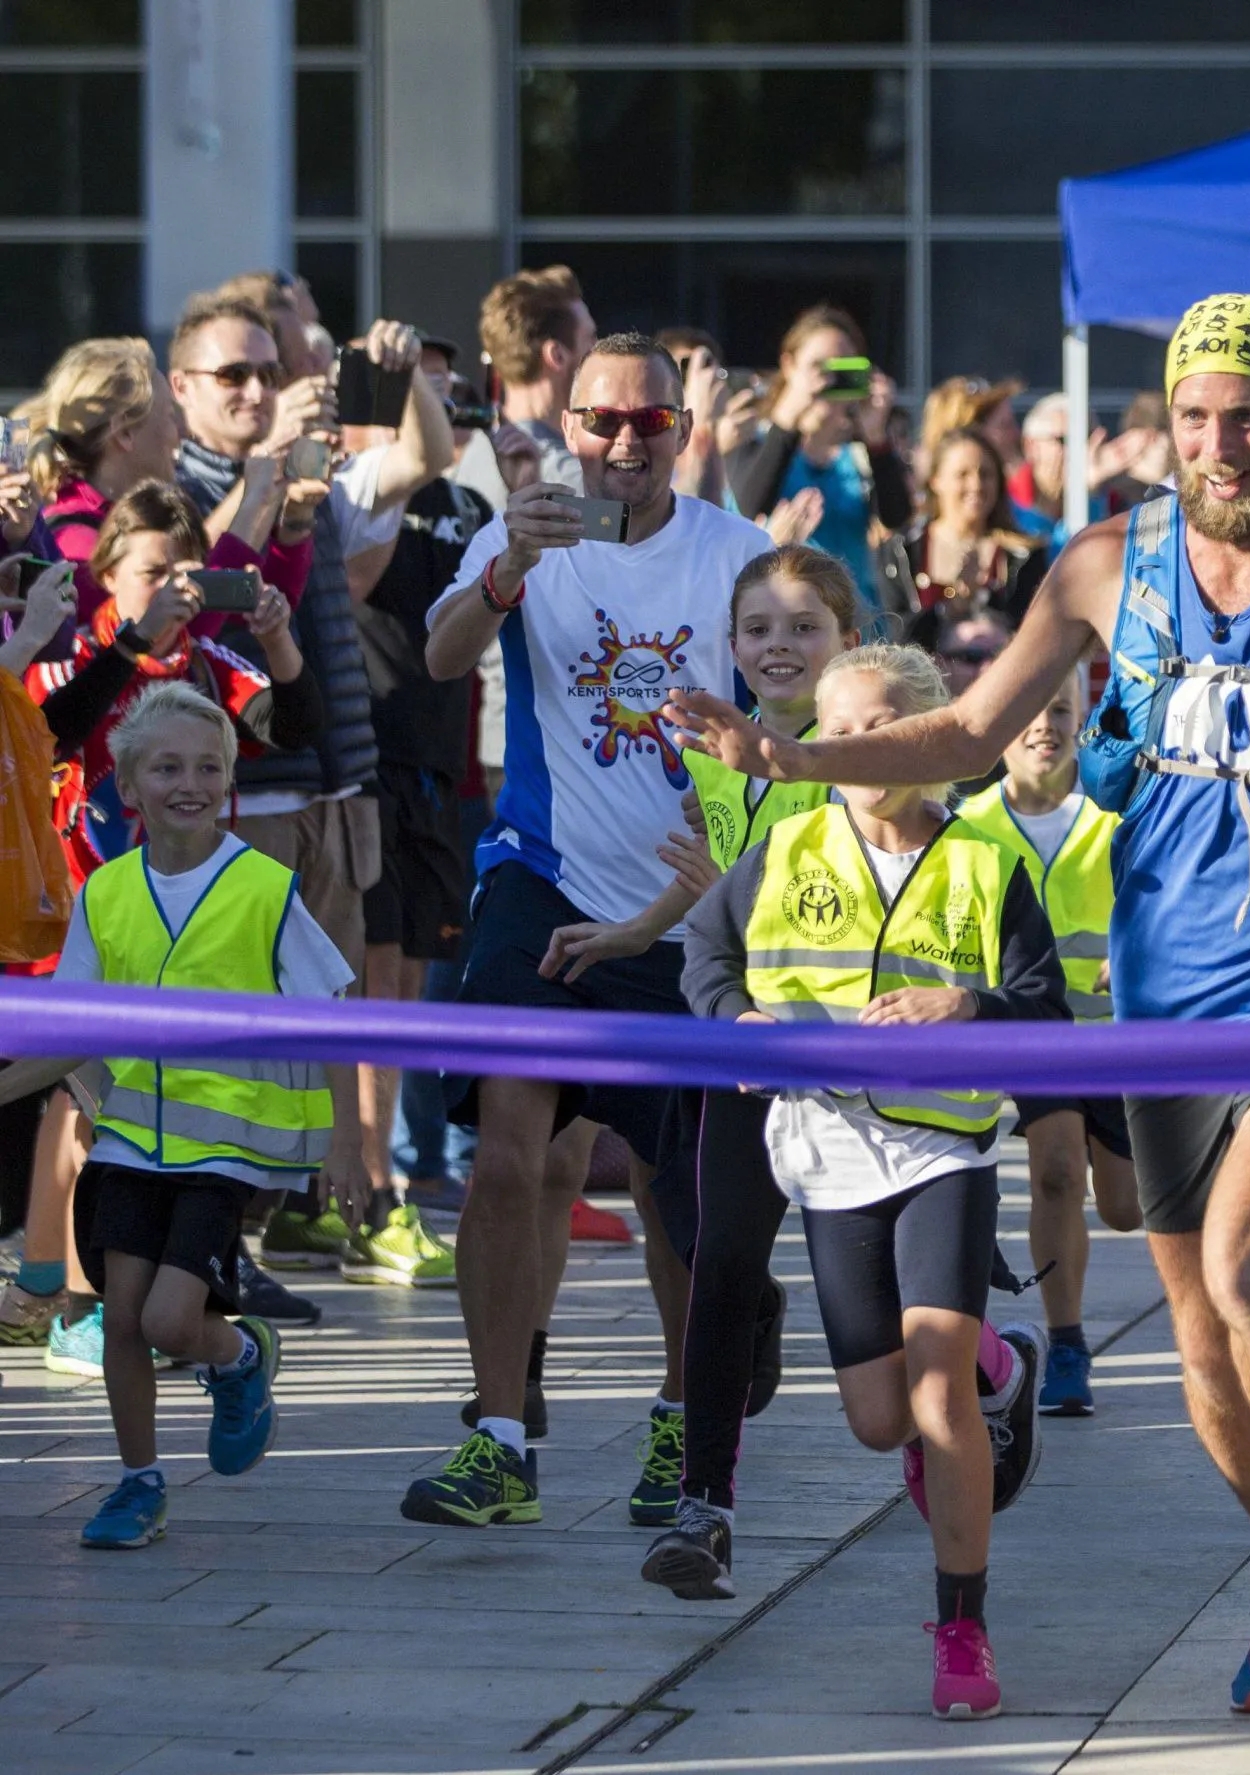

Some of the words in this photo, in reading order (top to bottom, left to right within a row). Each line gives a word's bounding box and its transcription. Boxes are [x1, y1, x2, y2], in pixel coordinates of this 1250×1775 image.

[1210, 301, 1246, 314] 401
[1194, 338, 1231, 354] 401
[567, 686, 605, 698] KENT
[608, 686, 661, 699] SPORTS
